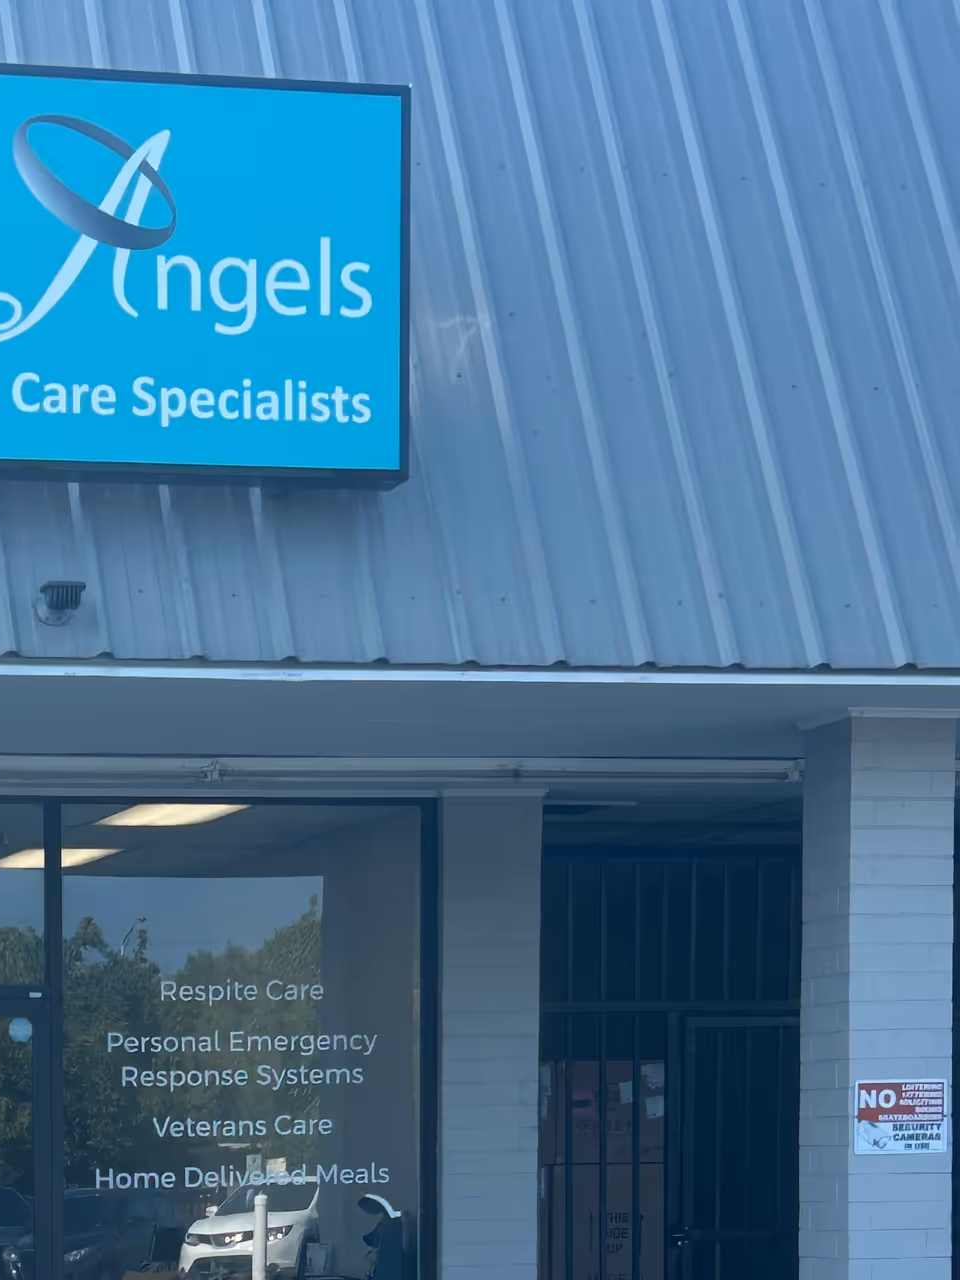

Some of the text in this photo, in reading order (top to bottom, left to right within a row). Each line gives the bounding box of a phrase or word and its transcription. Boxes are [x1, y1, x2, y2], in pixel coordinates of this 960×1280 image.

[12, 373, 115, 416] Care
[132, 376, 371, 427] Specialists
[161, 979, 324, 1005] Respite Care
[107, 1031, 378, 1055] Personal Emergency
[122, 1065, 363, 1092] Response Systems
[859, 1089, 896, 1109] NO
[153, 1115, 332, 1138] Veterans Care
[893, 1123, 942, 1131] SECURITY
[893, 1133, 941, 1142] CAMERAS
[95, 1163, 390, 1190] Home Delivered Meals
